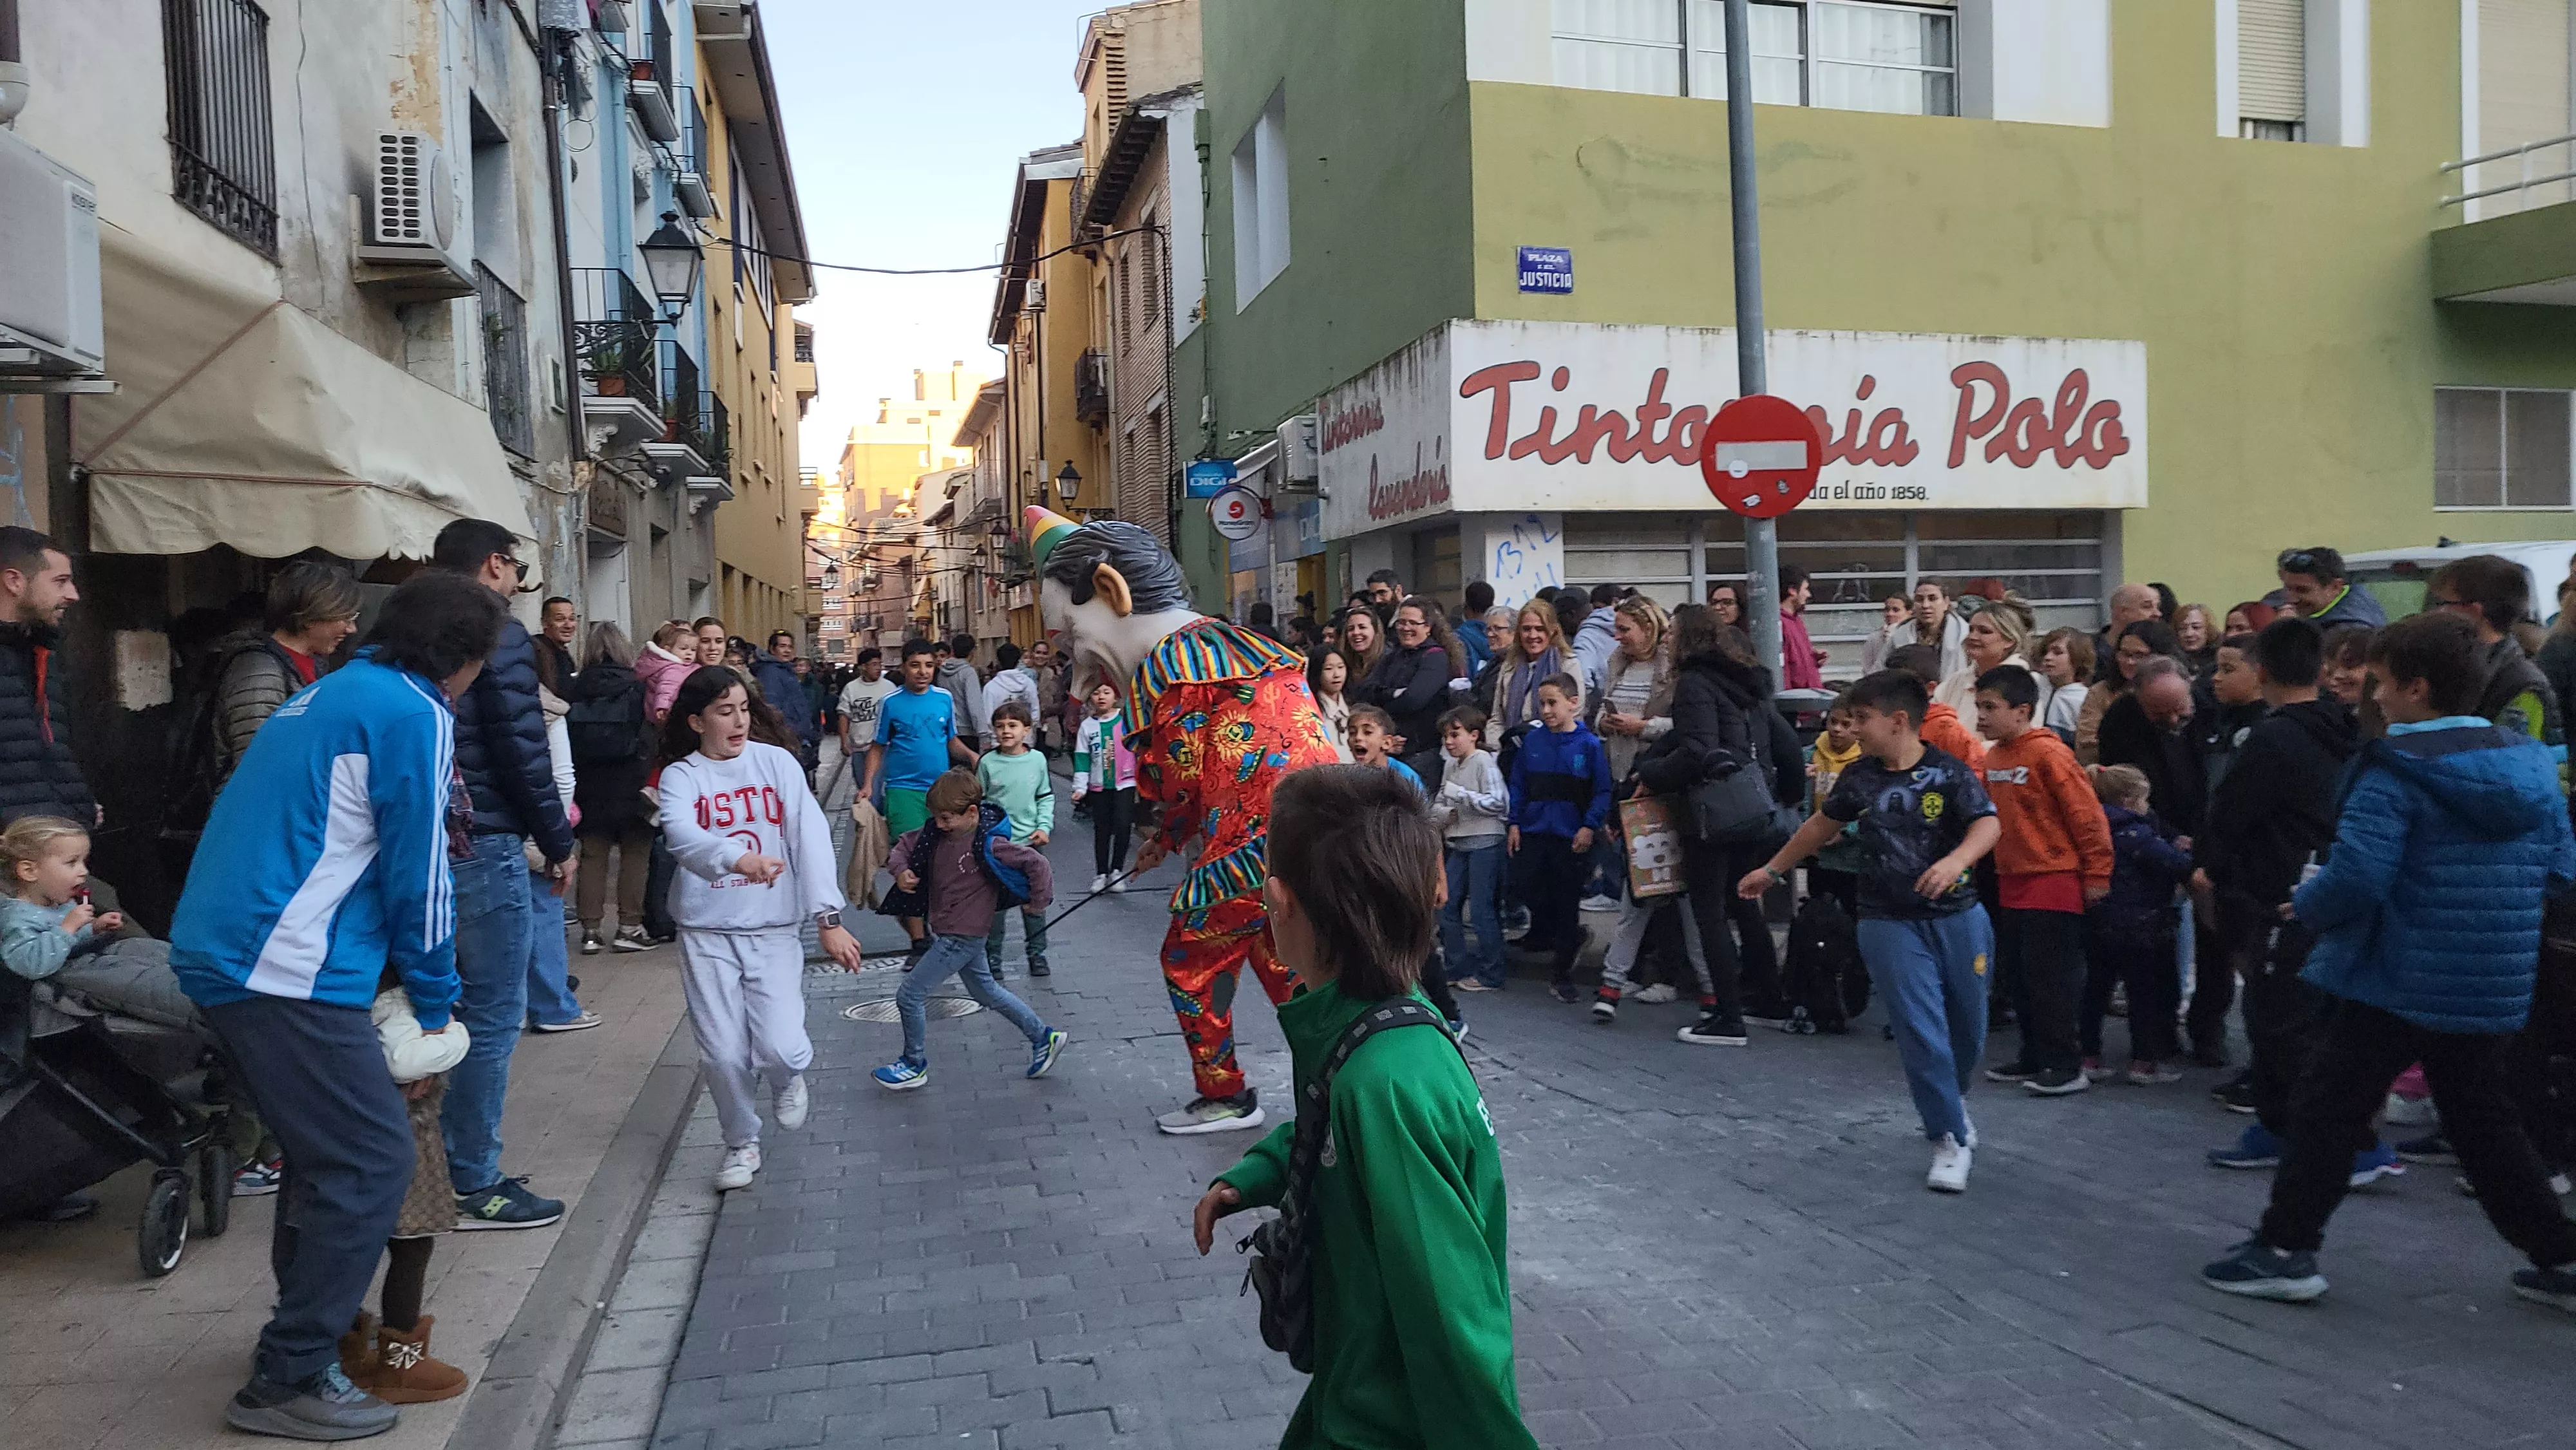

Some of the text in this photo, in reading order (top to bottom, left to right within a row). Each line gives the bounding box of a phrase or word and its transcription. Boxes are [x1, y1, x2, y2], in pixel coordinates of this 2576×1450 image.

[1528, 254, 1564, 263] PLAZA
[1519, 271, 1572, 288] JUSTICIA
[1947, 361, 2130, 470] Polo
[1189, 477, 1227, 486] DIGI
[1835, 480, 1850, 500] el
[1854, 482, 1886, 500] año
[1891, 485, 1930, 501] 1858.
[693, 786, 784, 838] OSTO
